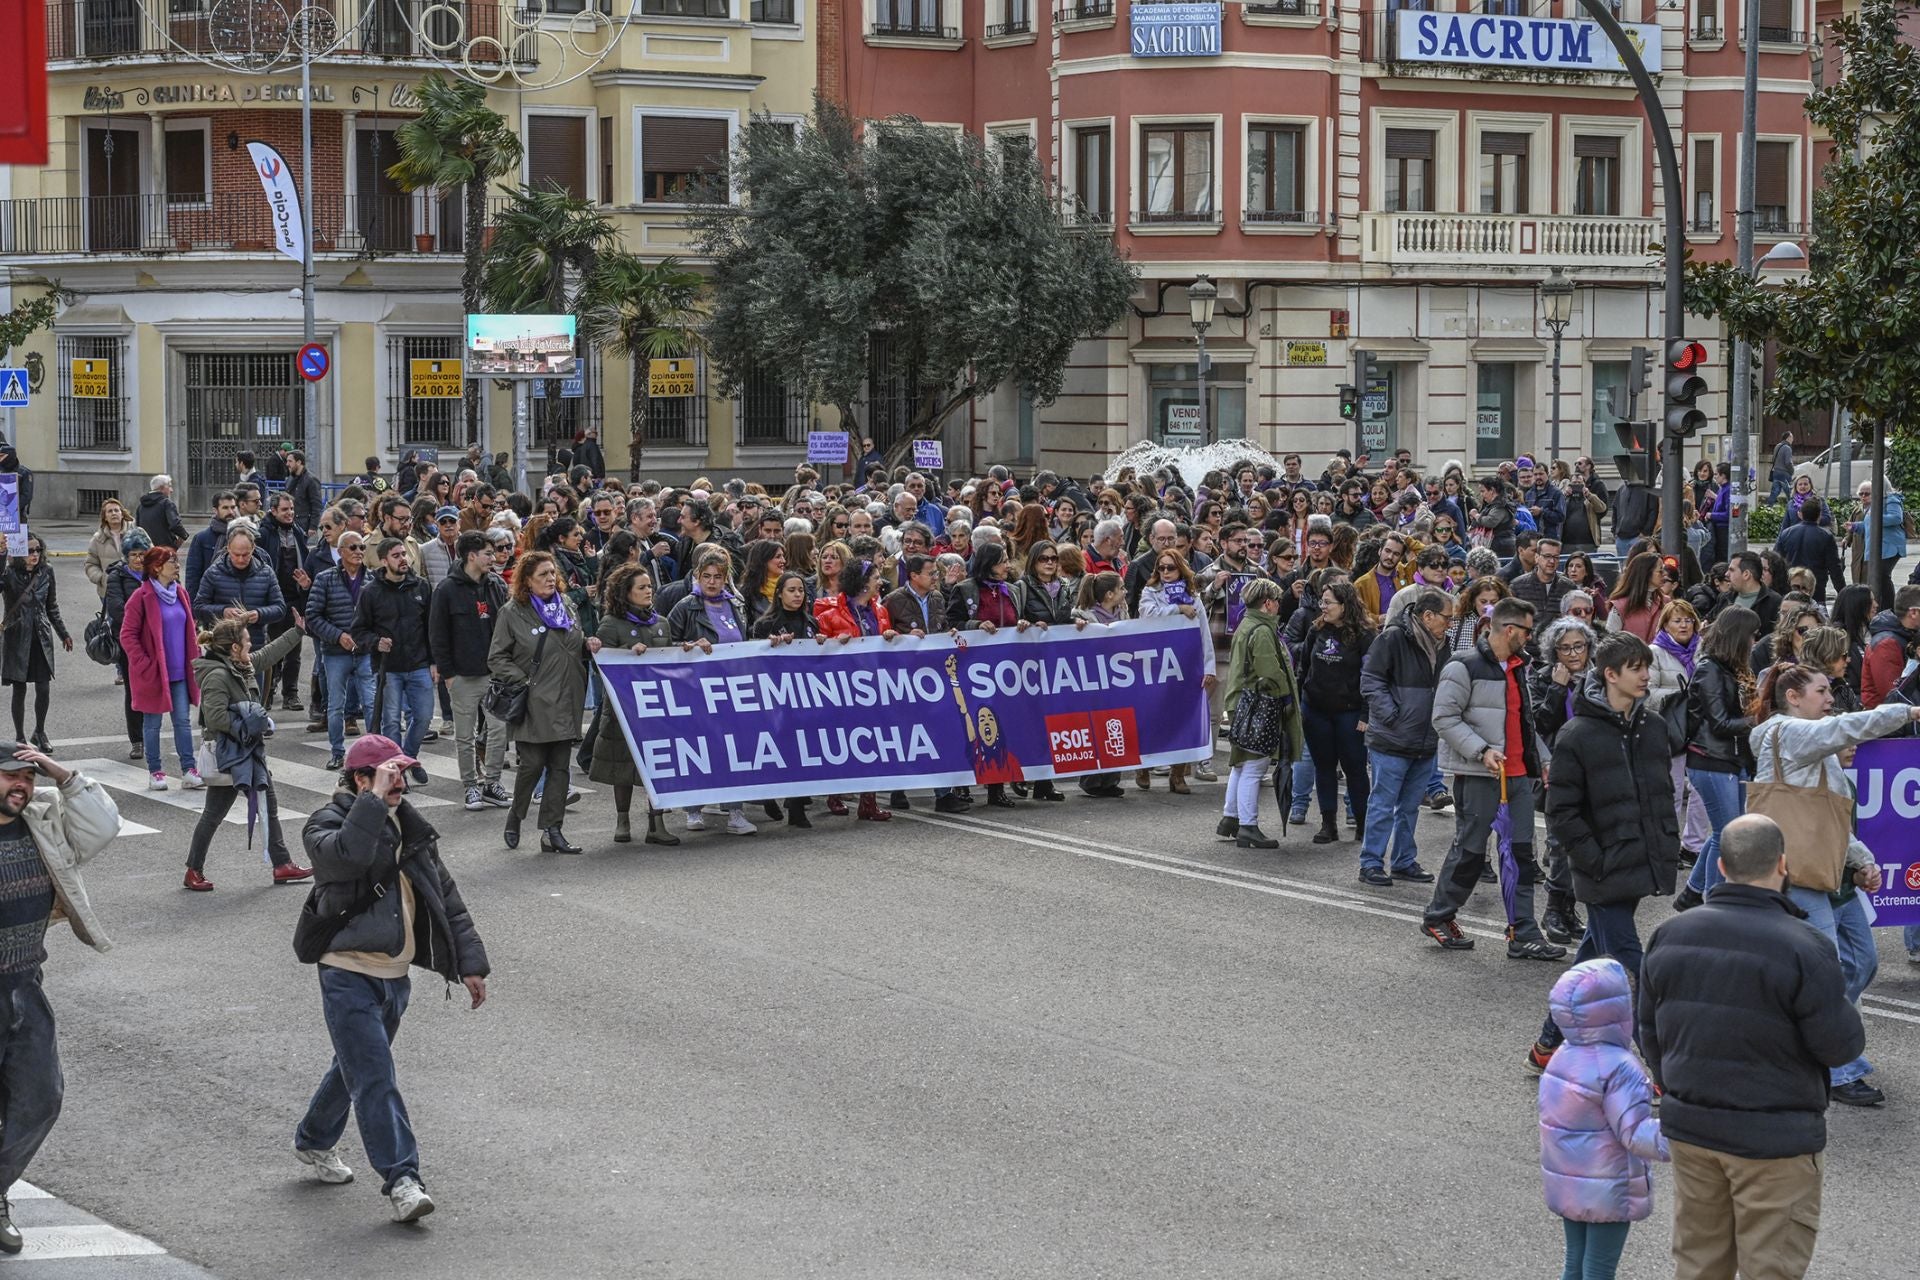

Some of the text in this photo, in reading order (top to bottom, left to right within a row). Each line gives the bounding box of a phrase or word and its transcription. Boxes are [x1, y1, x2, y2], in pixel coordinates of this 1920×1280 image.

[1134, 14, 1171, 22] MANUALES
[1133, 25, 1217, 53] SACRUM
[1418, 15, 1593, 64] SACRUM
[241, 84, 336, 103] DENTAL
[496, 340, 519, 350] Museo
[536, 340, 545, 350] de
[546, 340, 572, 351] Morales
[74, 384, 106, 395] 24 00 24
[414, 385, 460, 396] 24 00 24
[652, 384, 694, 395] 24 00 24
[1362, 425, 1384, 435] LQUILA
[920, 441, 935, 450] PAZ
[631, 647, 1184, 718] EL FEMINISMO SOCIALISTA
[1050, 728, 1092, 751] PSOE
[642, 723, 941, 779] EN LA LUCHA
[1054, 750, 1095, 763] BADAJOZ
